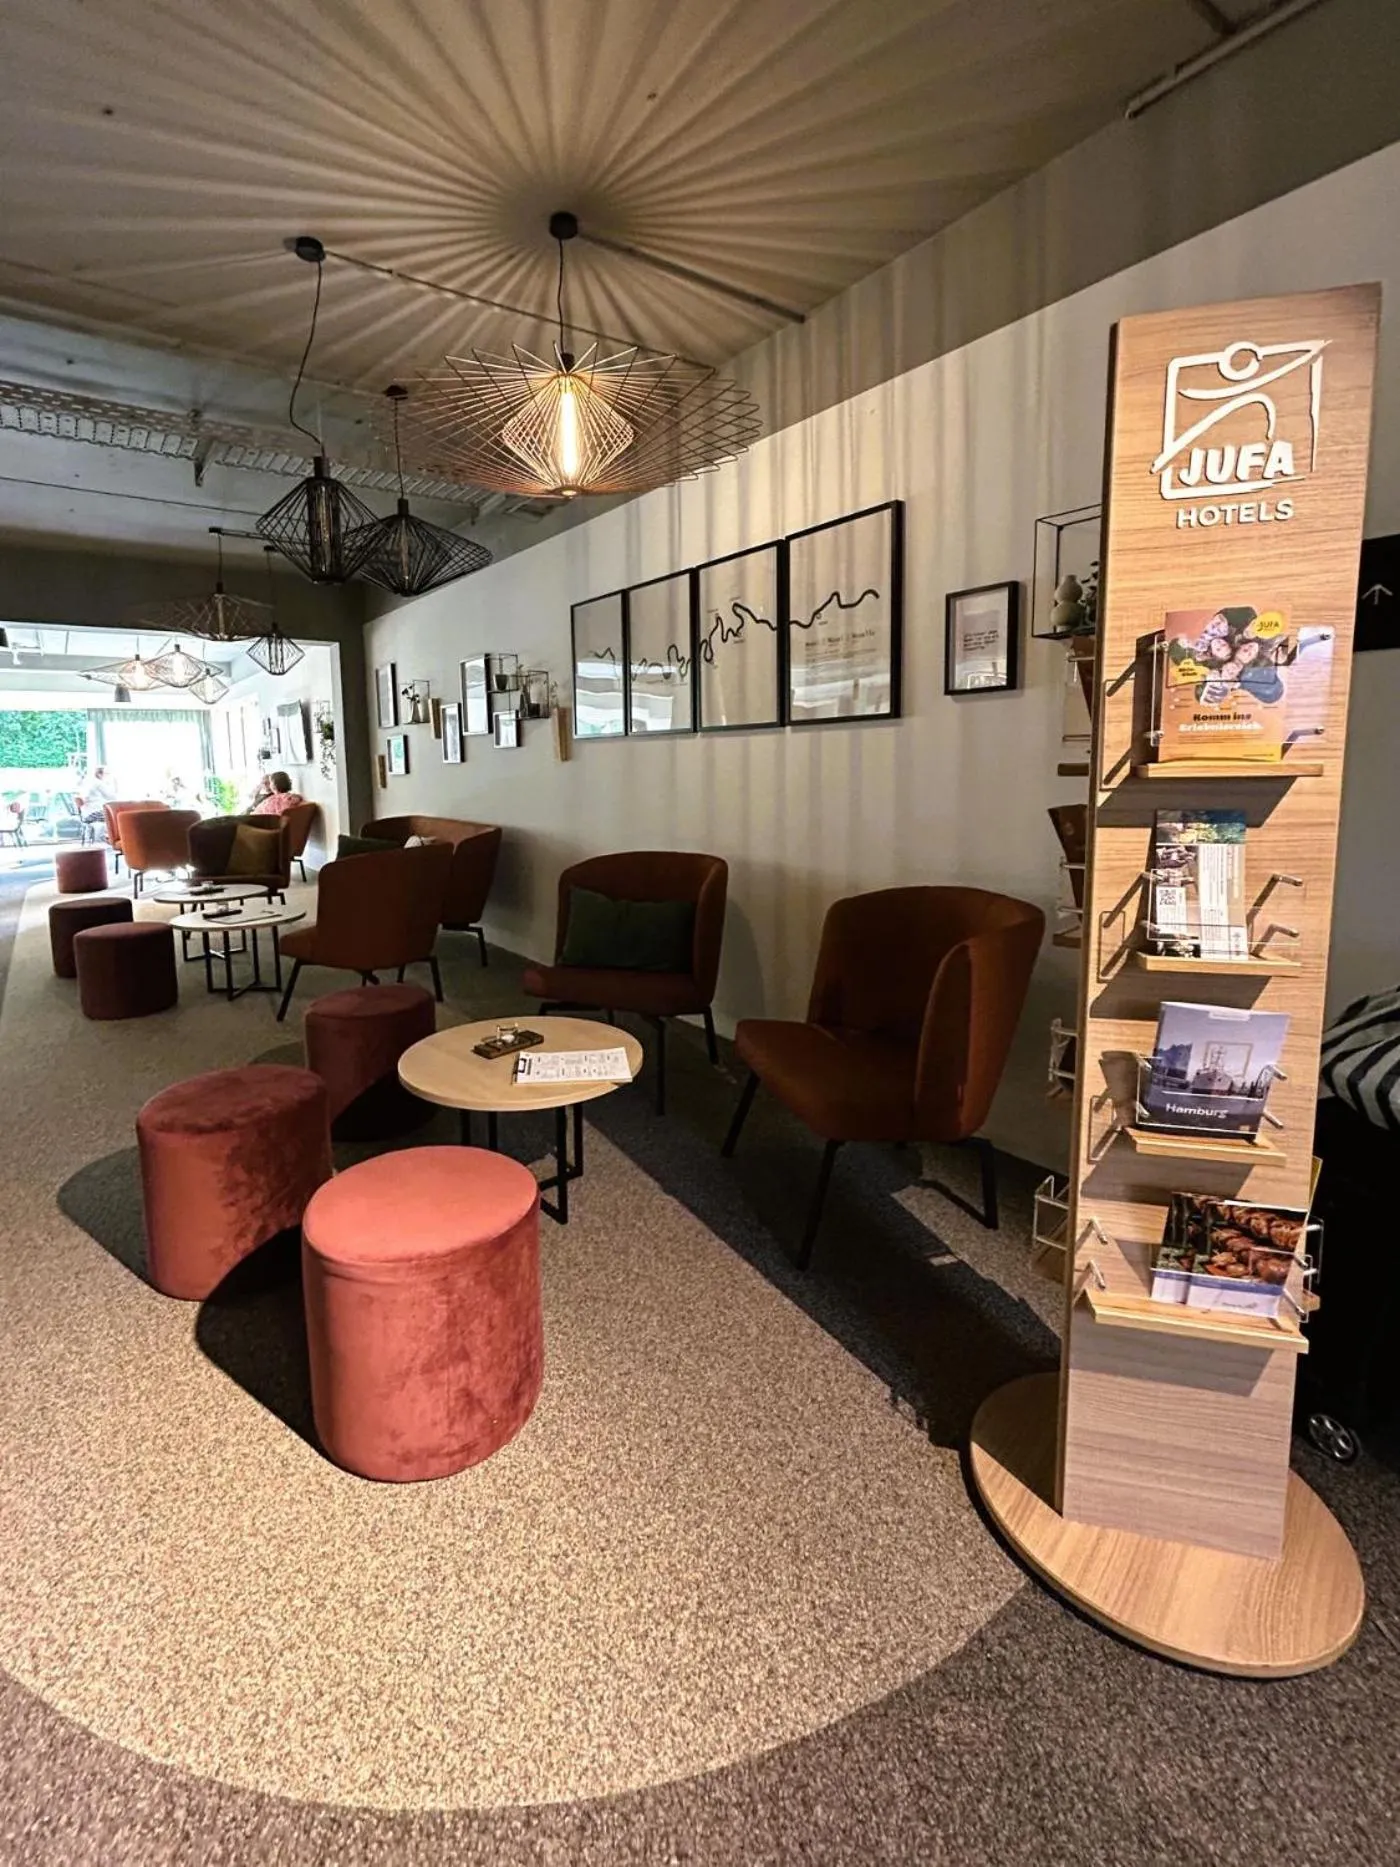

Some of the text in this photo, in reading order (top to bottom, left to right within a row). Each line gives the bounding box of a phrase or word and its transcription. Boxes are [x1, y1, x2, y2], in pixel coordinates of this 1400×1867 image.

[1178, 440, 1295, 486] JUFA
[1177, 498, 1294, 528] HOTELS
[1165, 1103, 1229, 1119] Hamburg
